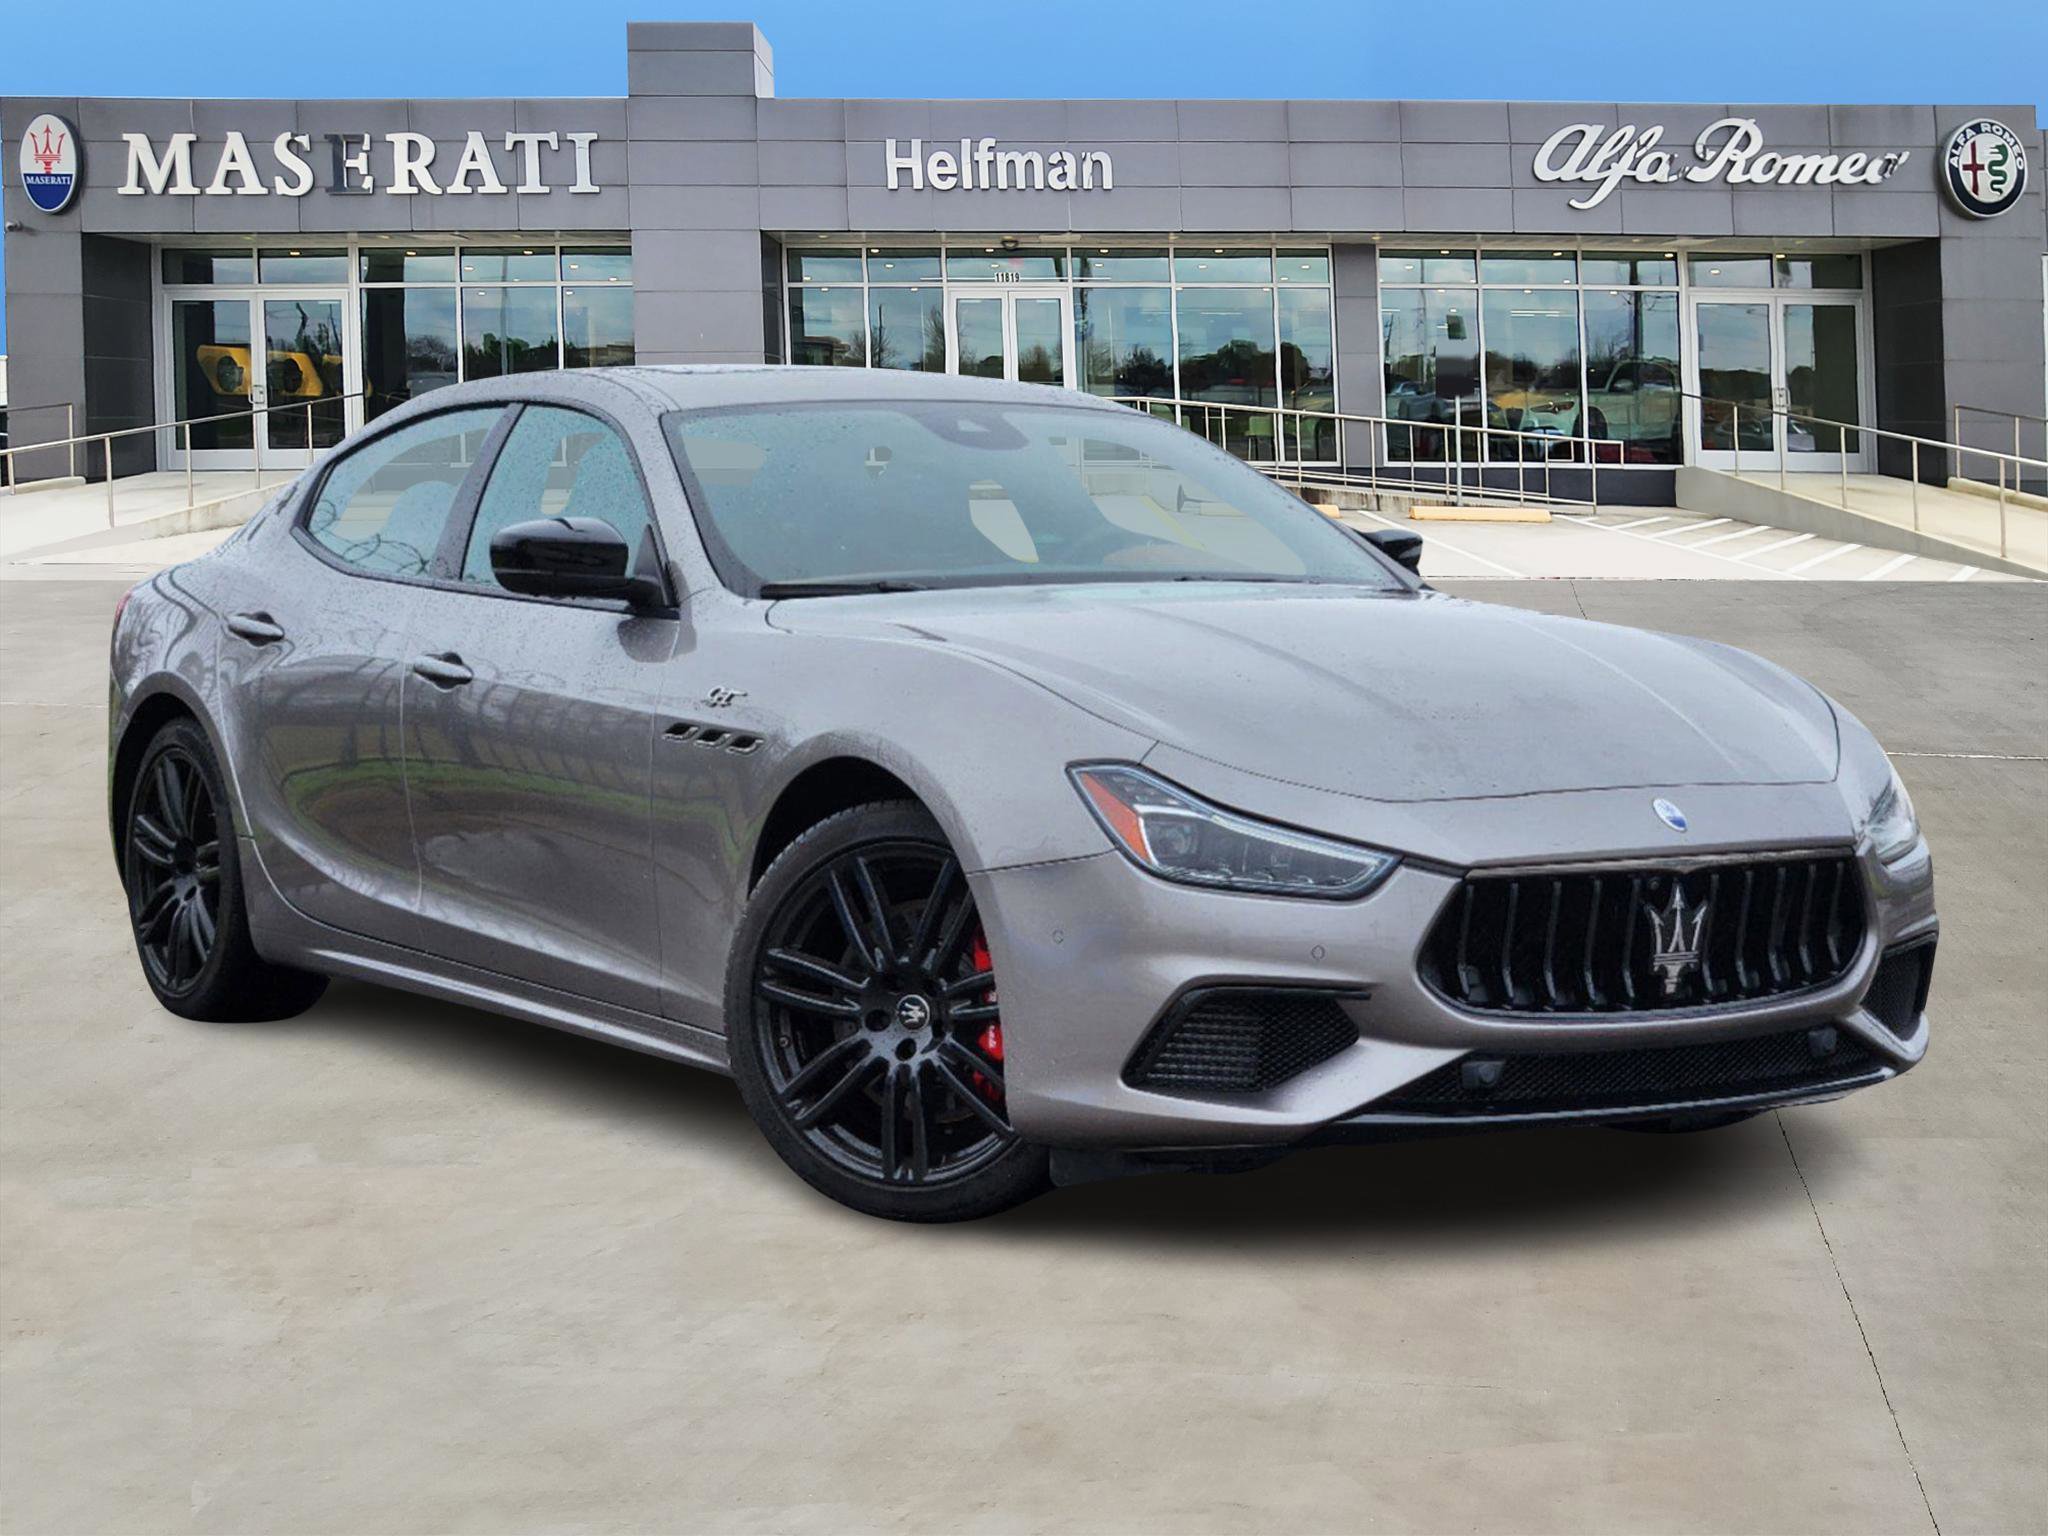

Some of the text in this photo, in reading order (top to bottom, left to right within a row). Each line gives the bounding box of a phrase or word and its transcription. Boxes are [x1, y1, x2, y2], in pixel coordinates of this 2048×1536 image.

[117, 131, 600, 197] MASERATI
[885, 137, 1114, 191] Helfman
[1533, 123, 1683, 209] Alfa
[1949, 122, 2024, 170] ALFA ROMEO
[26, 175, 71, 185] MASERATI
[995, 272, 1020, 283] 11819
